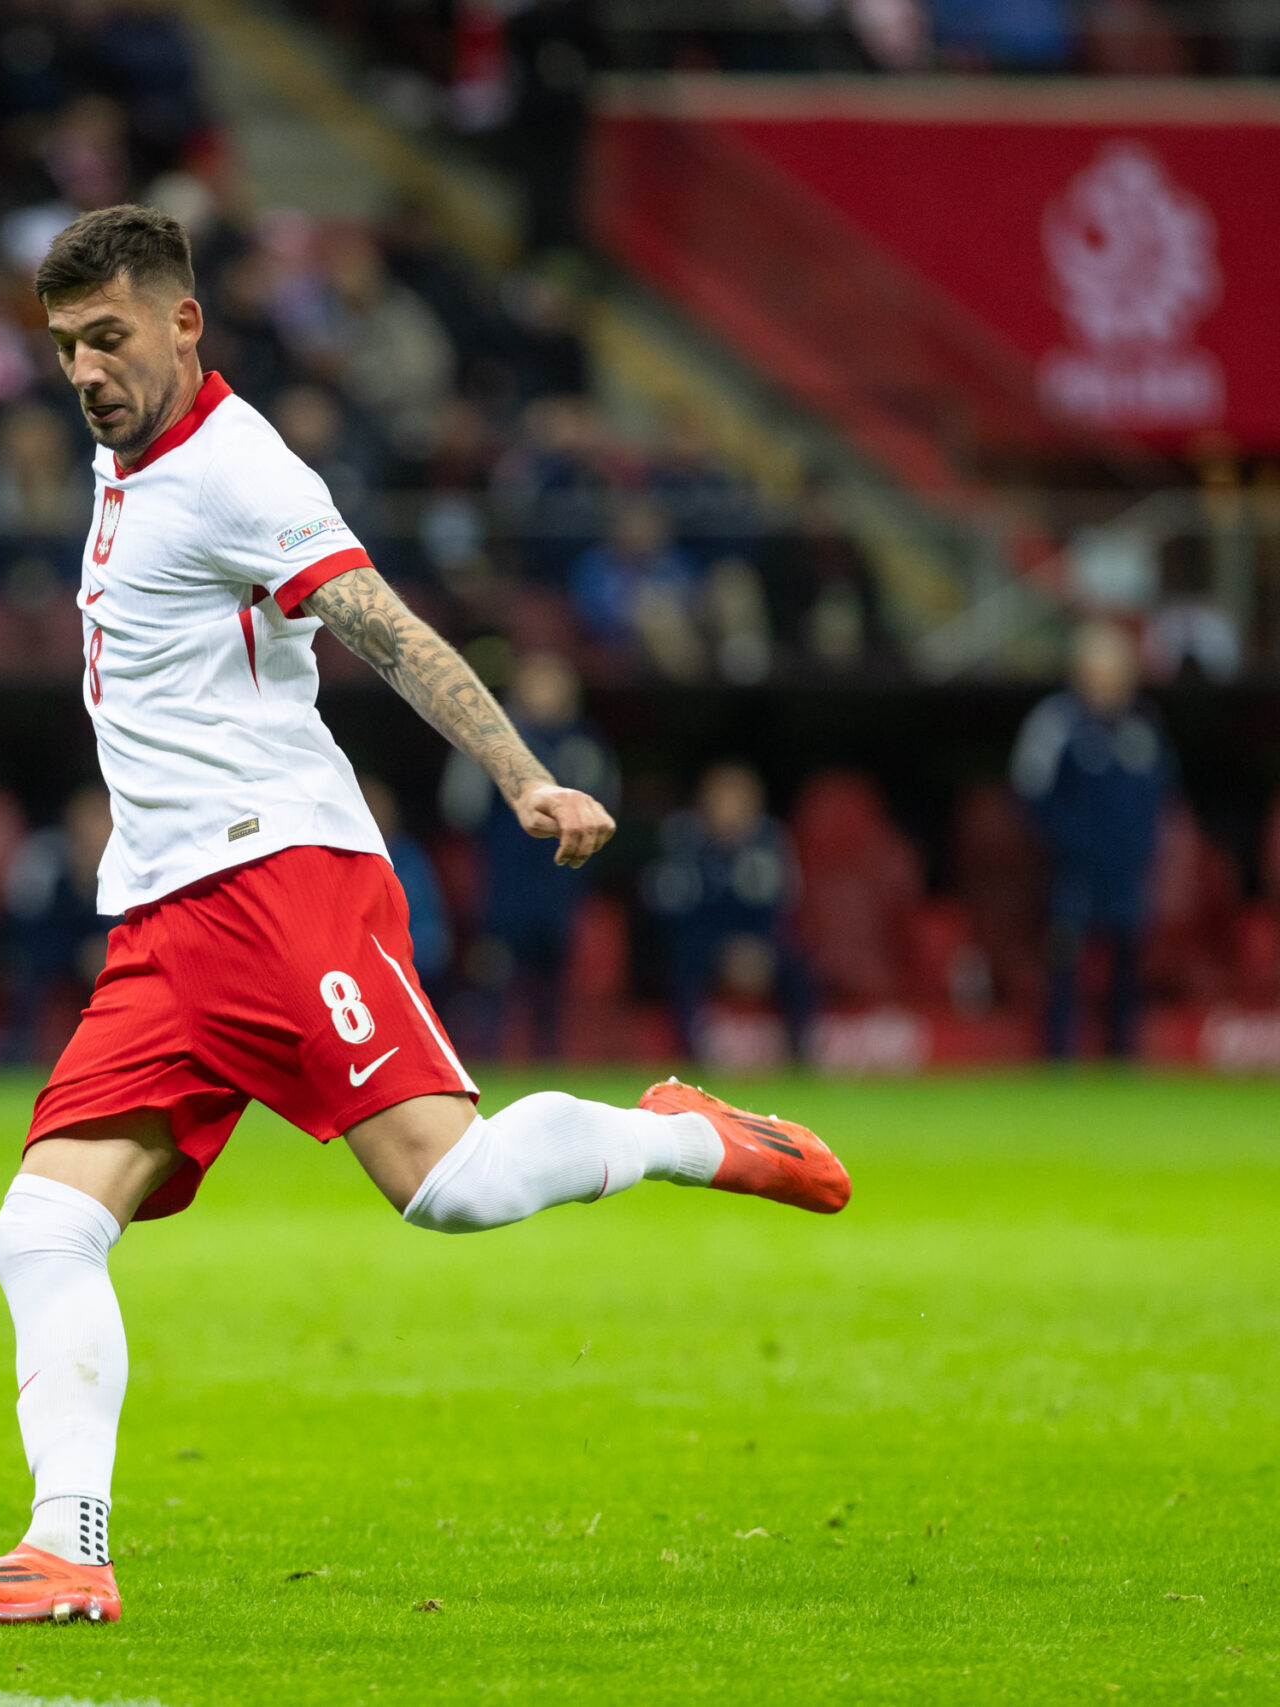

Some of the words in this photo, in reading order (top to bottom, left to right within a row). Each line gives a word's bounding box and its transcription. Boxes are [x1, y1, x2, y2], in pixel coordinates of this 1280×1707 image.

[277, 529, 292, 541] UEFA
[90, 627, 103, 707] 8
[320, 970, 375, 1044] 8
